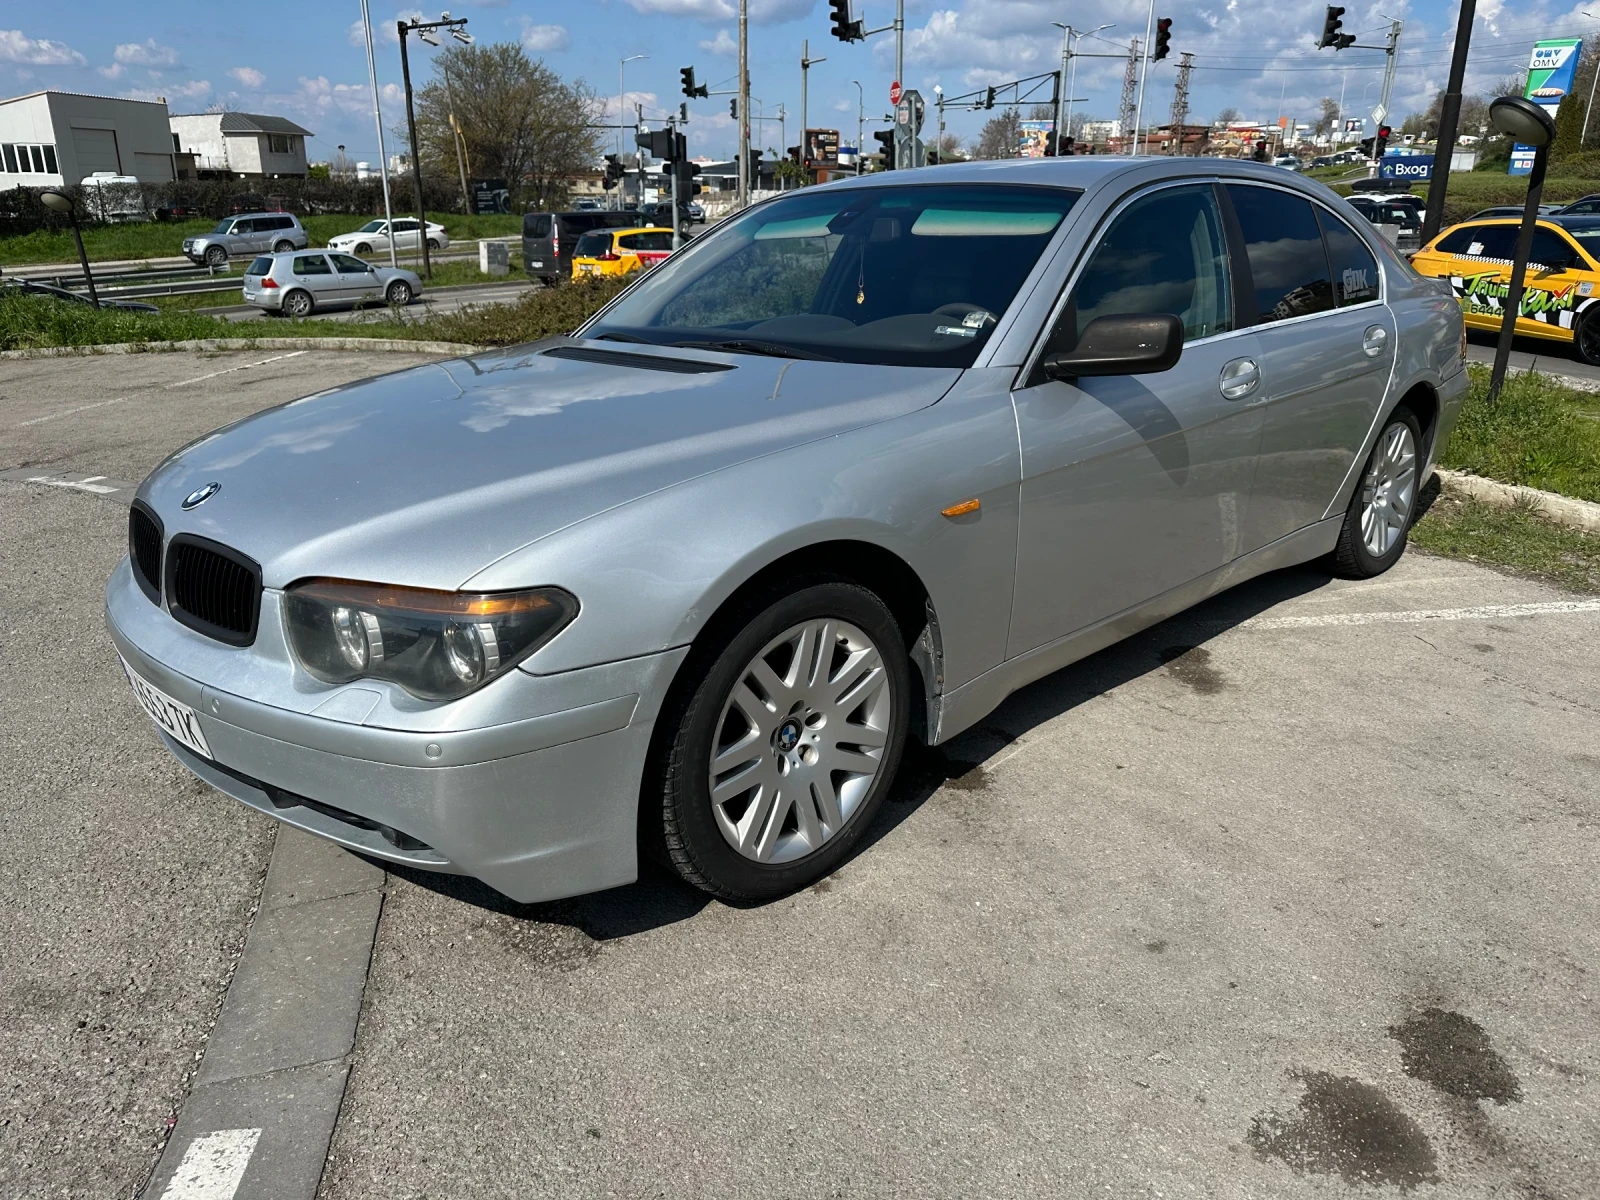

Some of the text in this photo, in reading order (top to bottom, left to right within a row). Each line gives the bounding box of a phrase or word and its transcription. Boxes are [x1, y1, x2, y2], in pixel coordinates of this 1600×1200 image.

[1533, 59, 1559, 67] OMV
[890, 87, 901, 99] STOP
[1463, 270, 1510, 298] Trium
[1470, 303, 1505, 317] 6444
